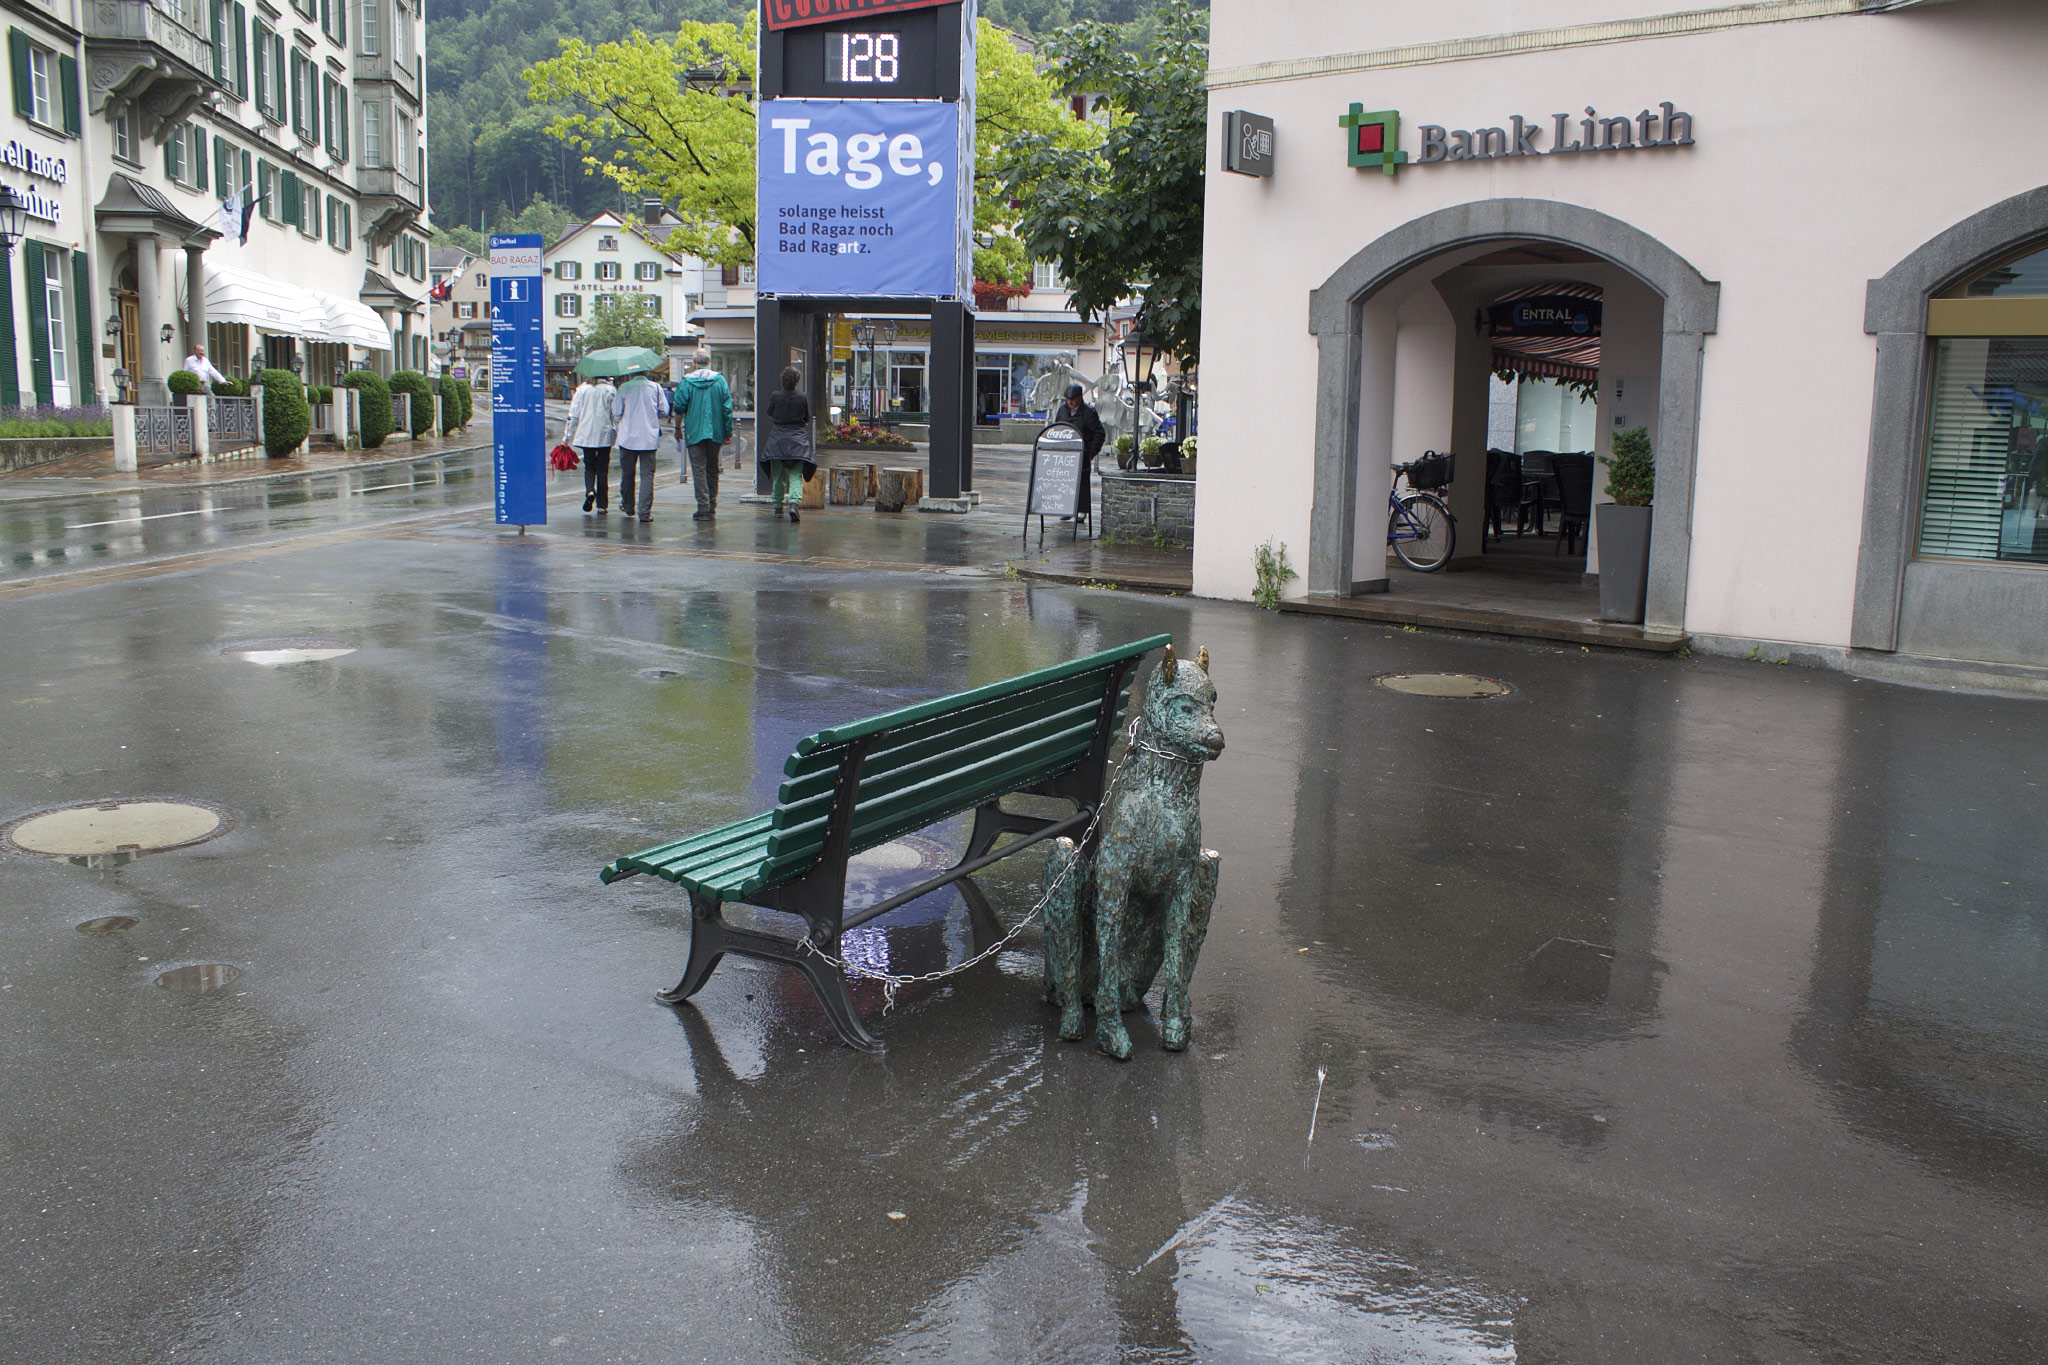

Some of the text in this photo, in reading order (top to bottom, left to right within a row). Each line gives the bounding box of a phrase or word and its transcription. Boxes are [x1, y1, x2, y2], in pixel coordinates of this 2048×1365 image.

[842, 33, 899, 82] 128
[1416, 101, 1696, 163] Bank Linth
[771, 118, 944, 190] Tage,
[29, 148, 69, 184] Hotel
[779, 204, 885, 221] solange heisst
[779, 222, 894, 239] Bad Ragaz noch
[779, 240, 872, 256] Bad Ragartz.
[491, 255, 539, 265] BAD RAGAZ
[573, 284, 644, 293] HOTEL KRONE
[1513, 302, 1572, 327] CENTRAL
[1042, 454, 1077, 467] 7 TAGE
[1046, 467, 1070, 478] offen
[497, 444, 509, 522] spavillage.ch
